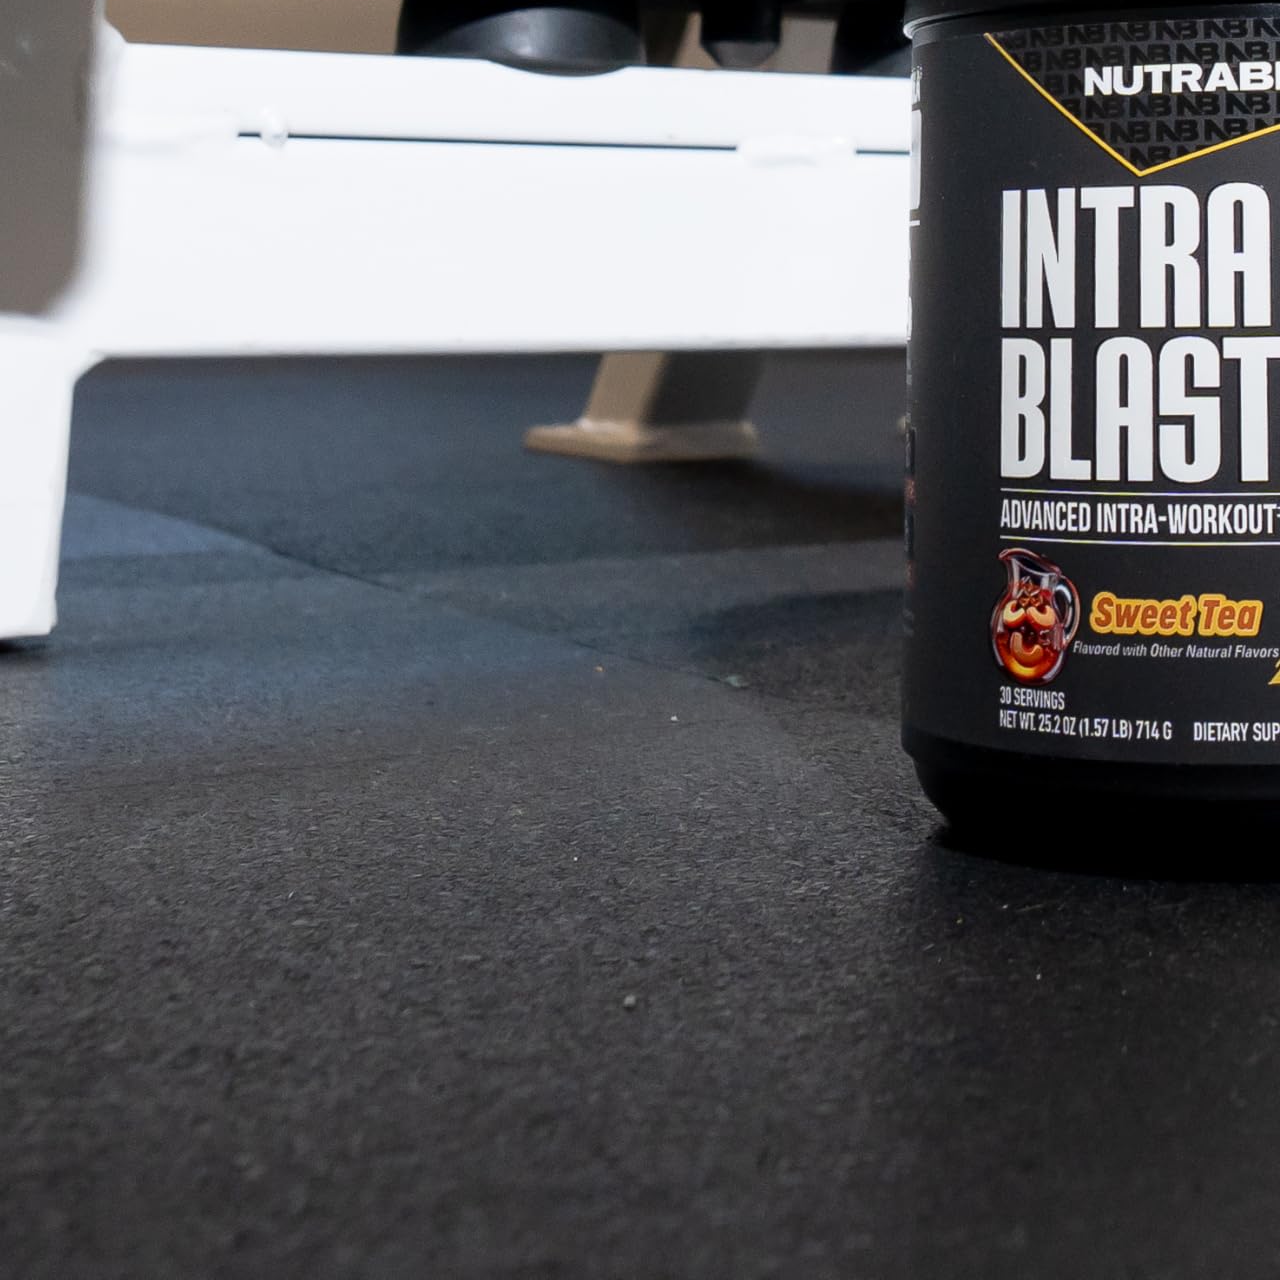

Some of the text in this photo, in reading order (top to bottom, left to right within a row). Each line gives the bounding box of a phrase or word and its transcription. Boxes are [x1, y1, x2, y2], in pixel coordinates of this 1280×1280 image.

[1001, 182, 1271, 329] INTRA
[1000, 499, 1091, 533] ADVANCED
[1091, 593, 1263, 636] Sweet Tea
[1073, 640, 1280, 659] Flavored with Other Natural Flavors
[1000, 686, 1065, 710] 30 SERVINGS
[1000, 710, 1172, 741] NET WT. 25.2 OZ (1.57 LB) 714 G
[1193, 722, 1250, 742] DIETARY
